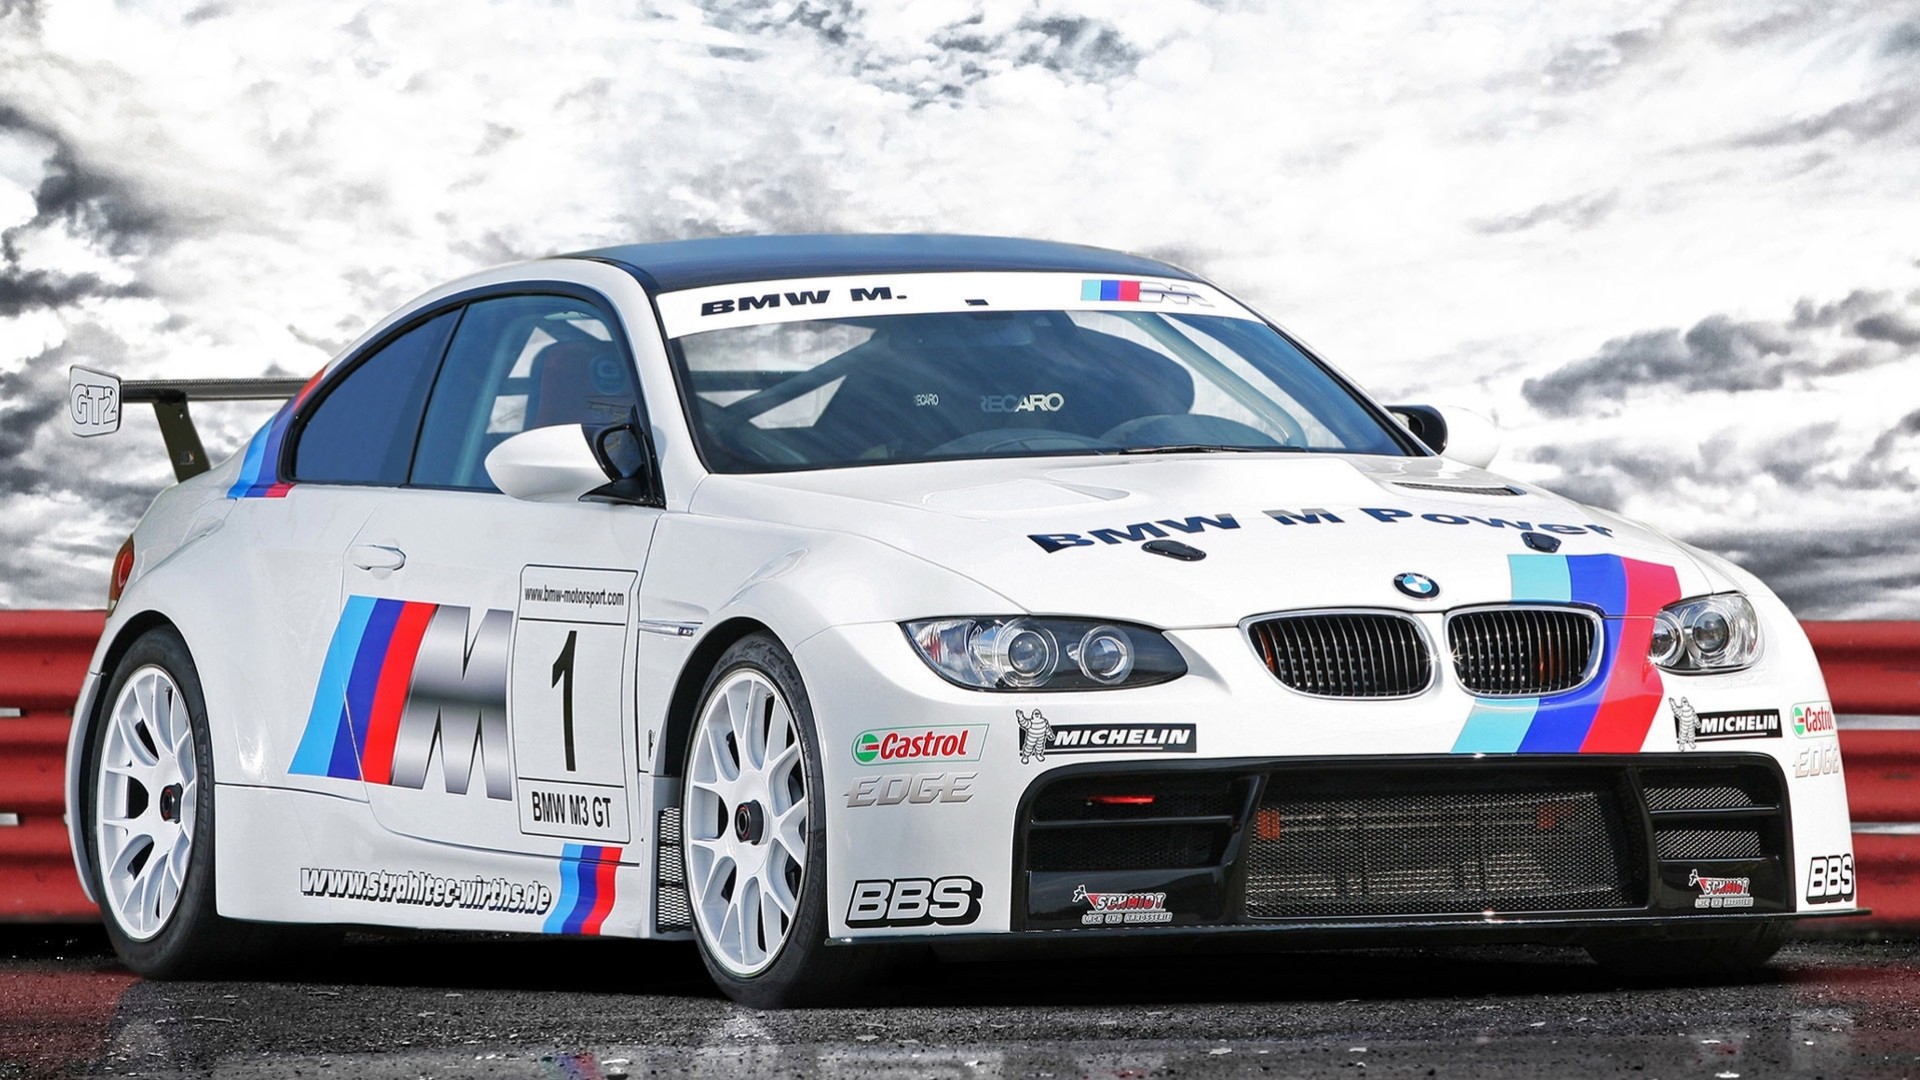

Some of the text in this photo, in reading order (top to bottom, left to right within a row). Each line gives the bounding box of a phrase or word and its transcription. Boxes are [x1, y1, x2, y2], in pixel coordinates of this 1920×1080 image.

[701, 290, 830, 316] BMW
[71, 383, 117, 425] GT2
[1027, 507, 1613, 554] BMW M Power
[524, 584, 625, 609] www.bmw-motorsport.com
[551, 630, 577, 773] 1
[1054, 728, 1191, 746] MICHELIN
[1700, 714, 1779, 734] MICHELIN
[881, 730, 969, 760] Castrol
[843, 771, 979, 808] EDGE
[531, 791, 611, 828] BMW M3 GT
[300, 867, 552, 915] www.strahltec-wirths.de
[1704, 877, 1750, 895] SCHMIDT
[1806, 853, 1855, 905] BBS
[845, 876, 984, 928] BBS
[1096, 892, 1166, 911] SCHMIDT
